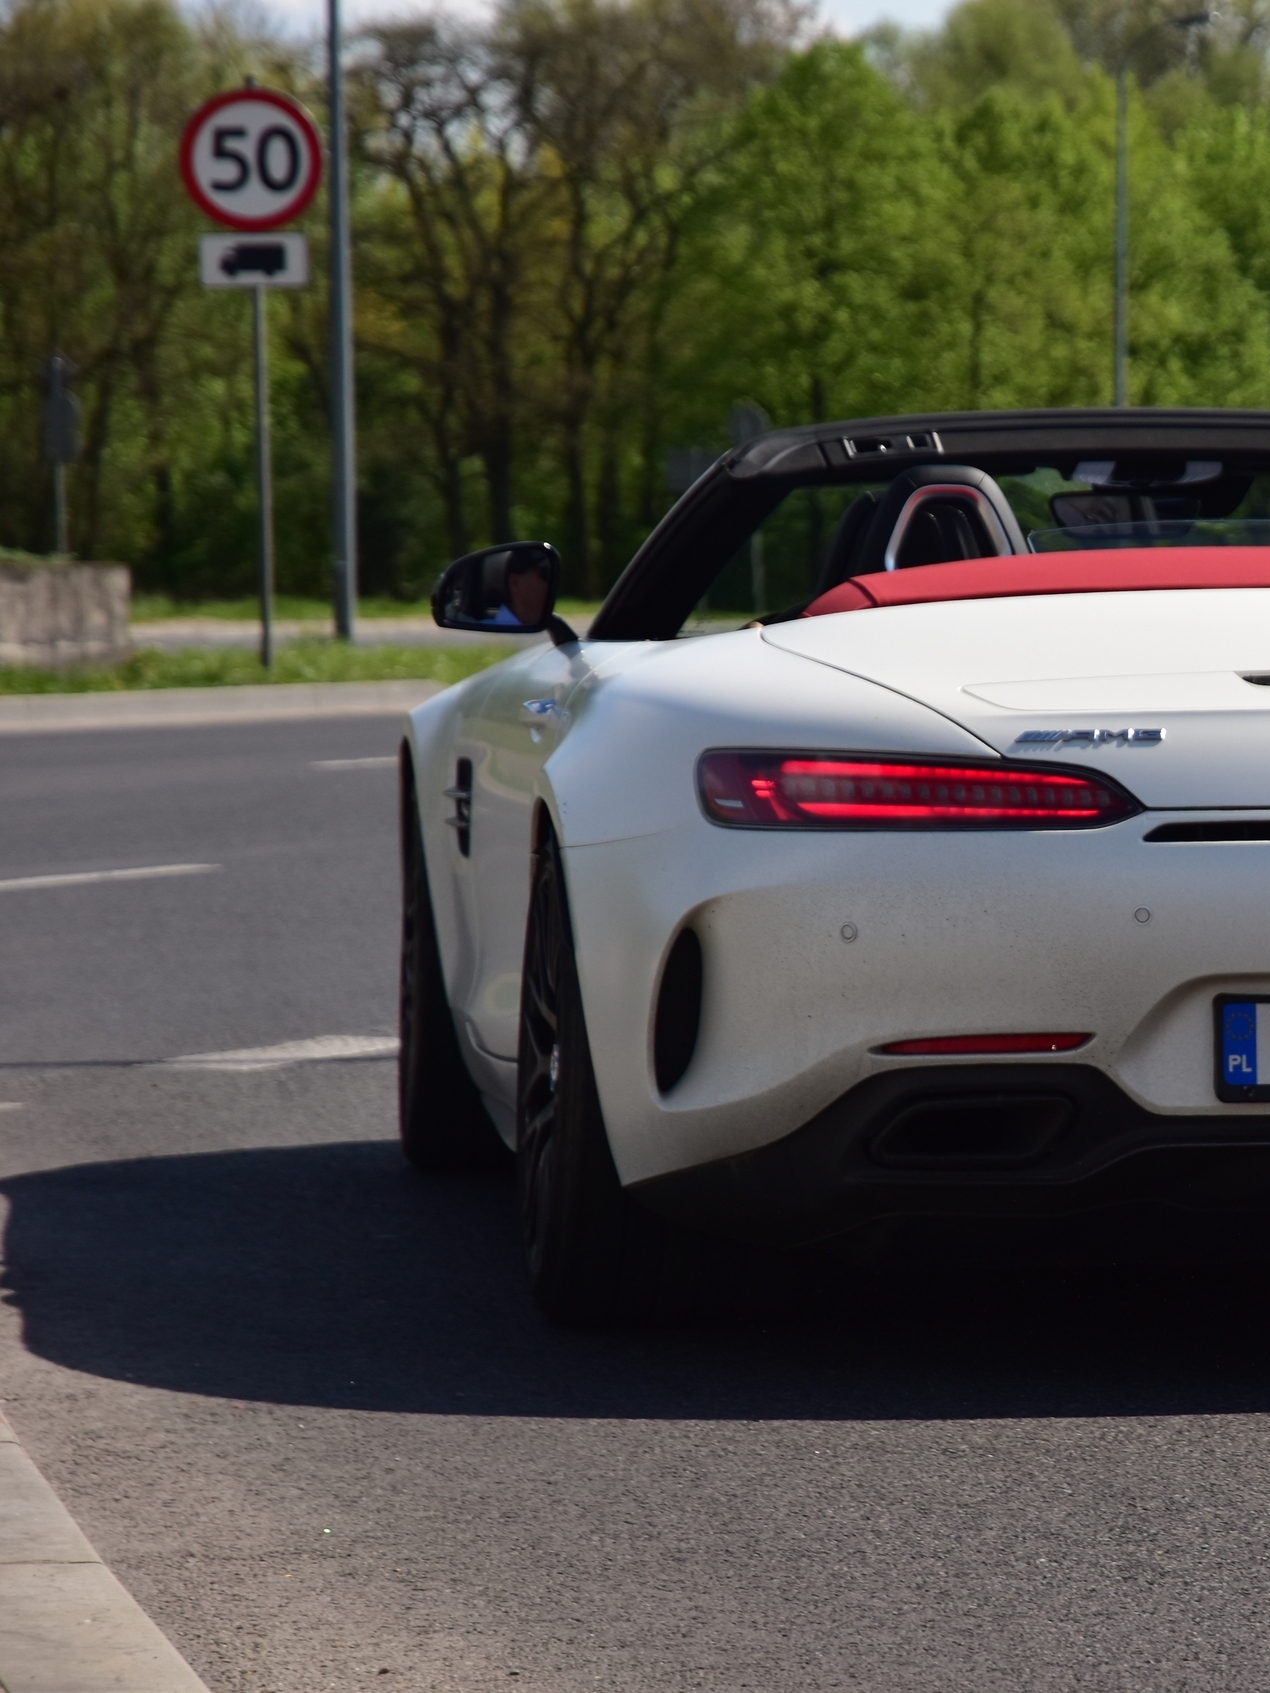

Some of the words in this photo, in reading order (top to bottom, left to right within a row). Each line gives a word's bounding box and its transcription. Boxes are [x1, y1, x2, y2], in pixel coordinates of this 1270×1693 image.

[209, 124, 301, 194] 50
[1061, 728, 1167, 742] AMG
[1228, 1054, 1253, 1073] PL
